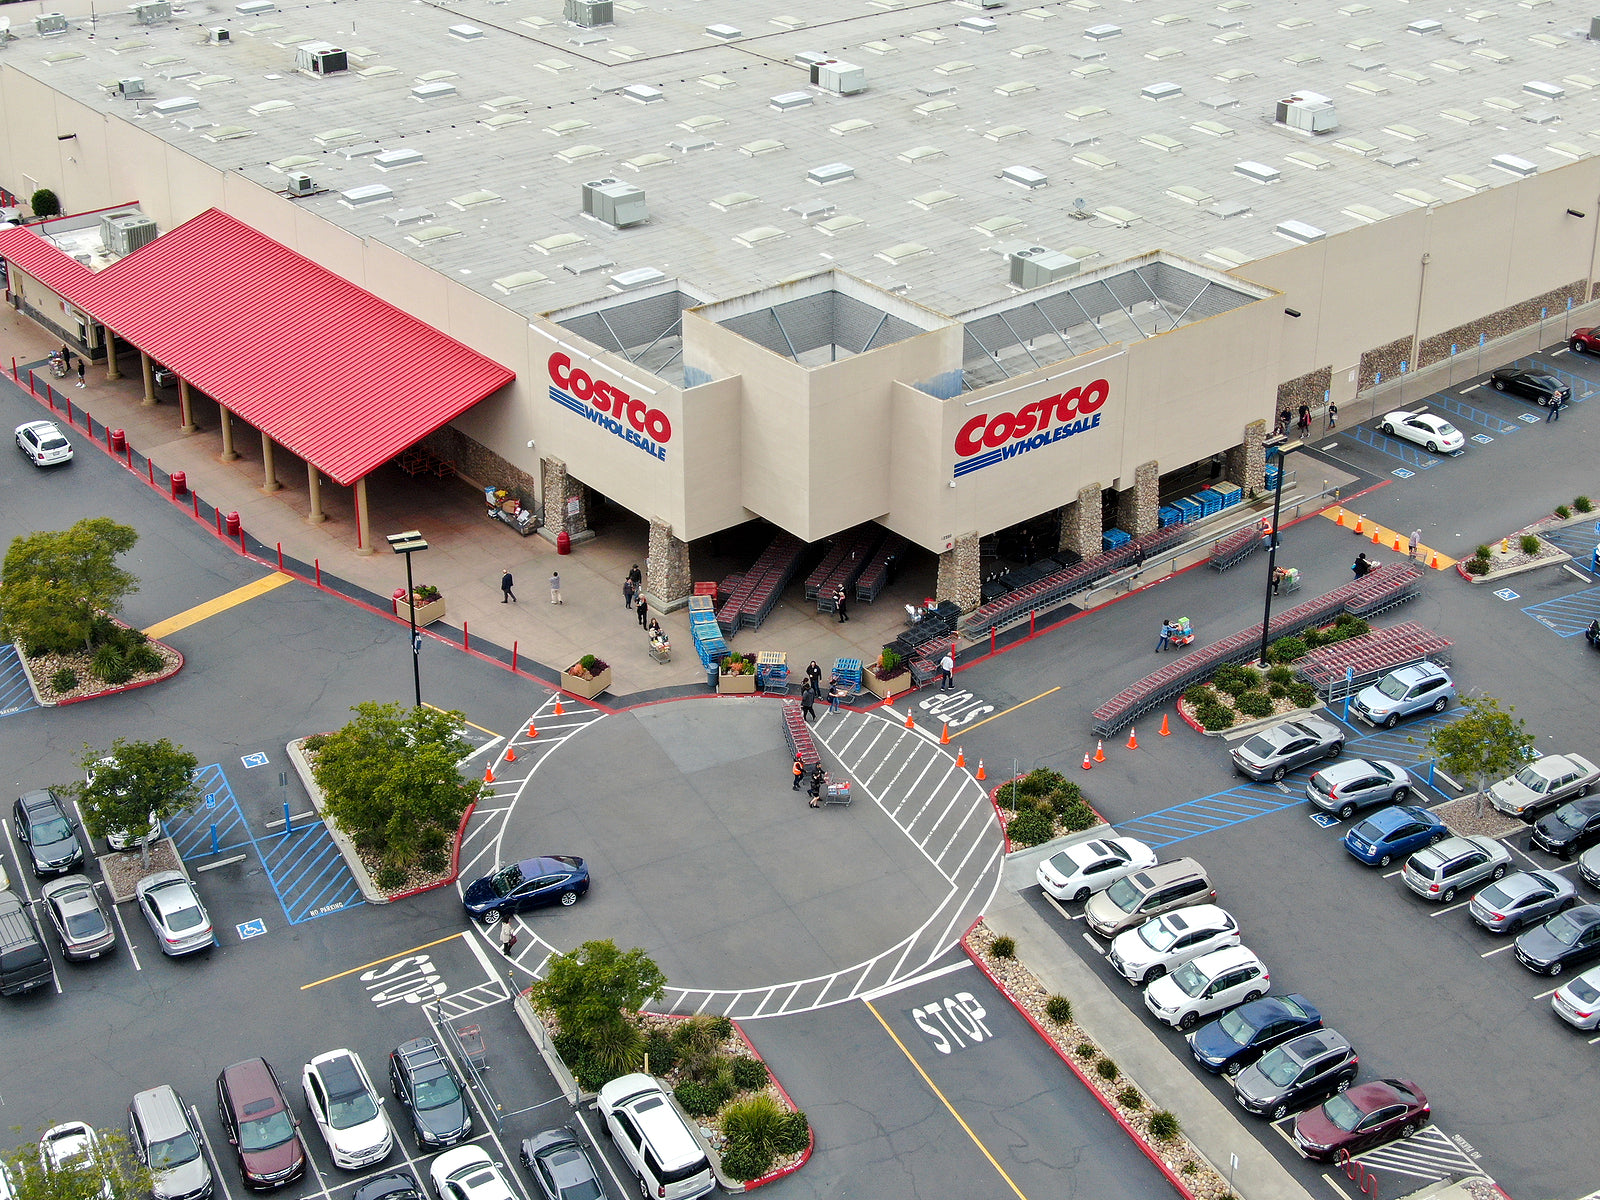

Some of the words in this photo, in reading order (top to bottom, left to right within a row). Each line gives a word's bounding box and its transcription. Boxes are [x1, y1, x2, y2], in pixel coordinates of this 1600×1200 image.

[548, 352, 672, 443] COSTCO
[954, 378, 1110, 457] COSTCO
[583, 405, 666, 462] WHOLESALE
[1001, 412, 1102, 461] WHOLESALE
[918, 689, 995, 727] STOP
[309, 909, 319, 917] NO
[320, 901, 344, 914] PARKING
[359, 954, 448, 1009] STOP
[912, 991, 994, 1055] STOP
